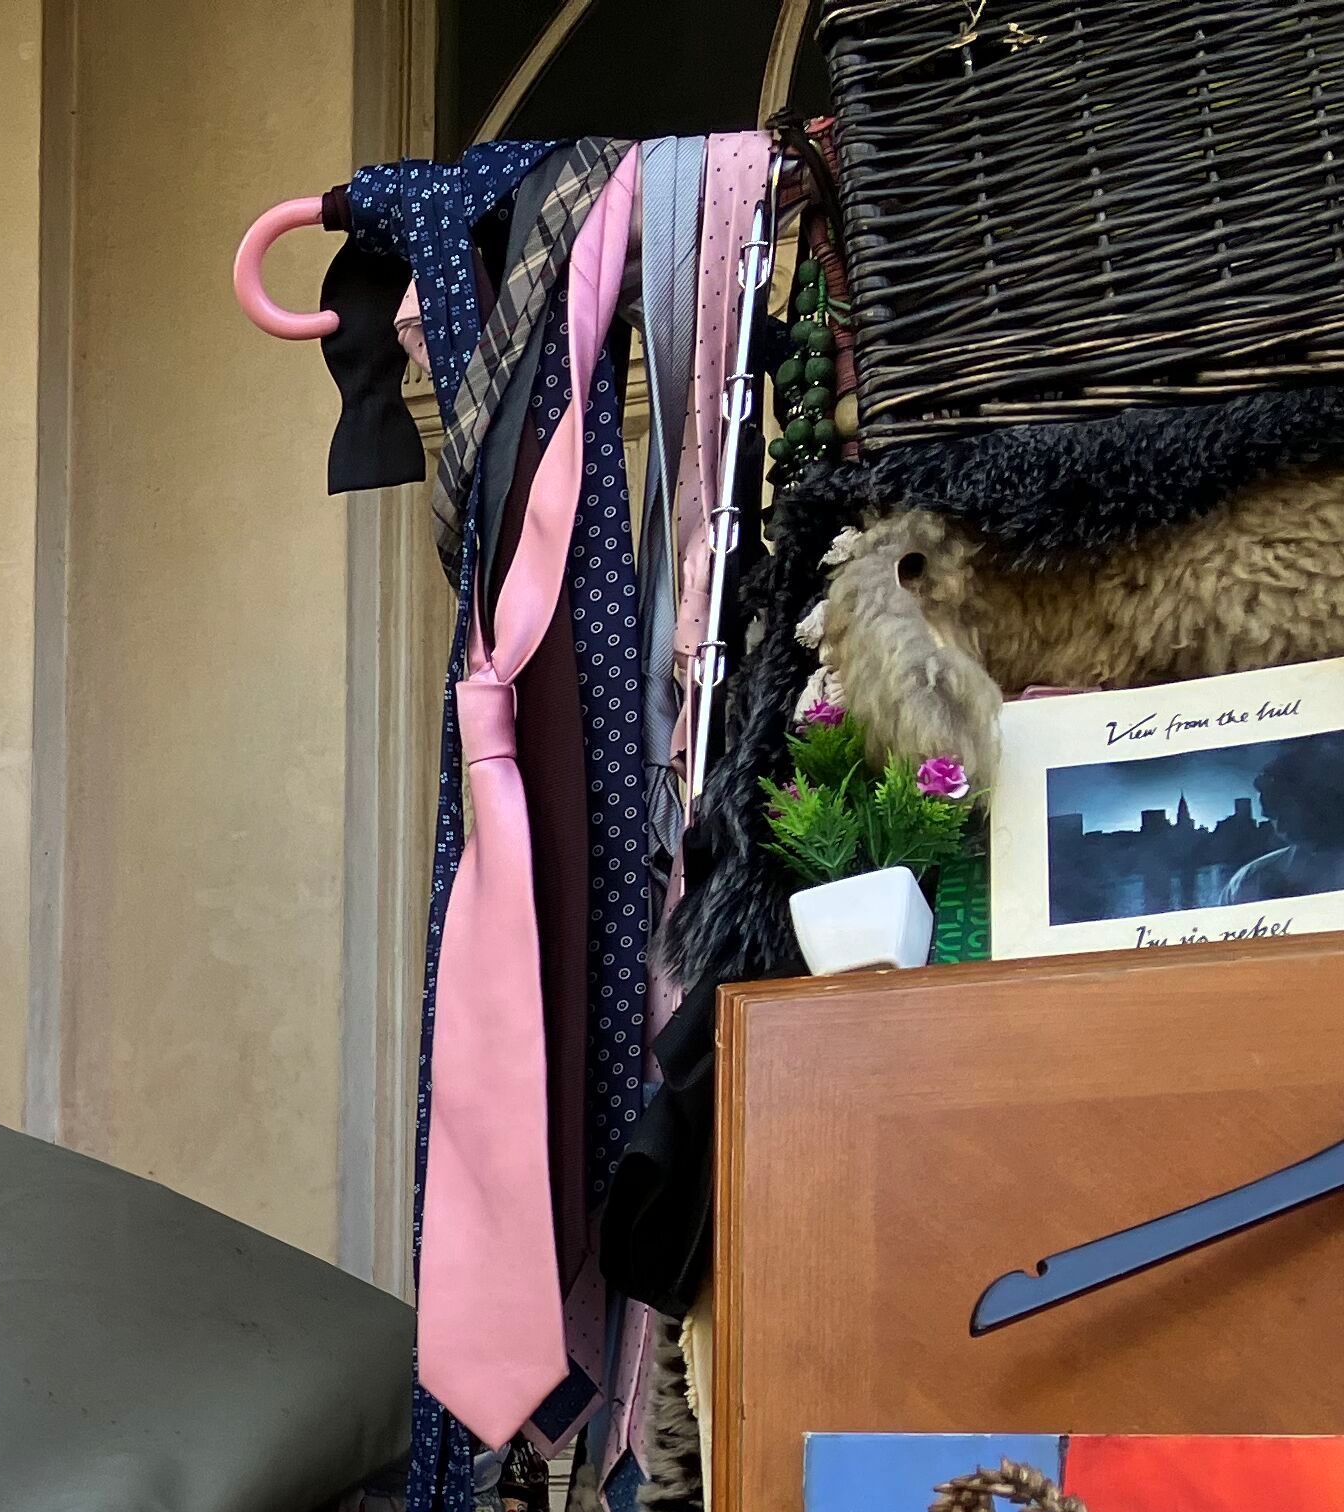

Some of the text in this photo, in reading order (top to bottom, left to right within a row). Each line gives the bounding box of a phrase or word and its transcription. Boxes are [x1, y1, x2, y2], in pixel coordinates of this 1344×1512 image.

[1106, 699, 1302, 745] View from the hill
